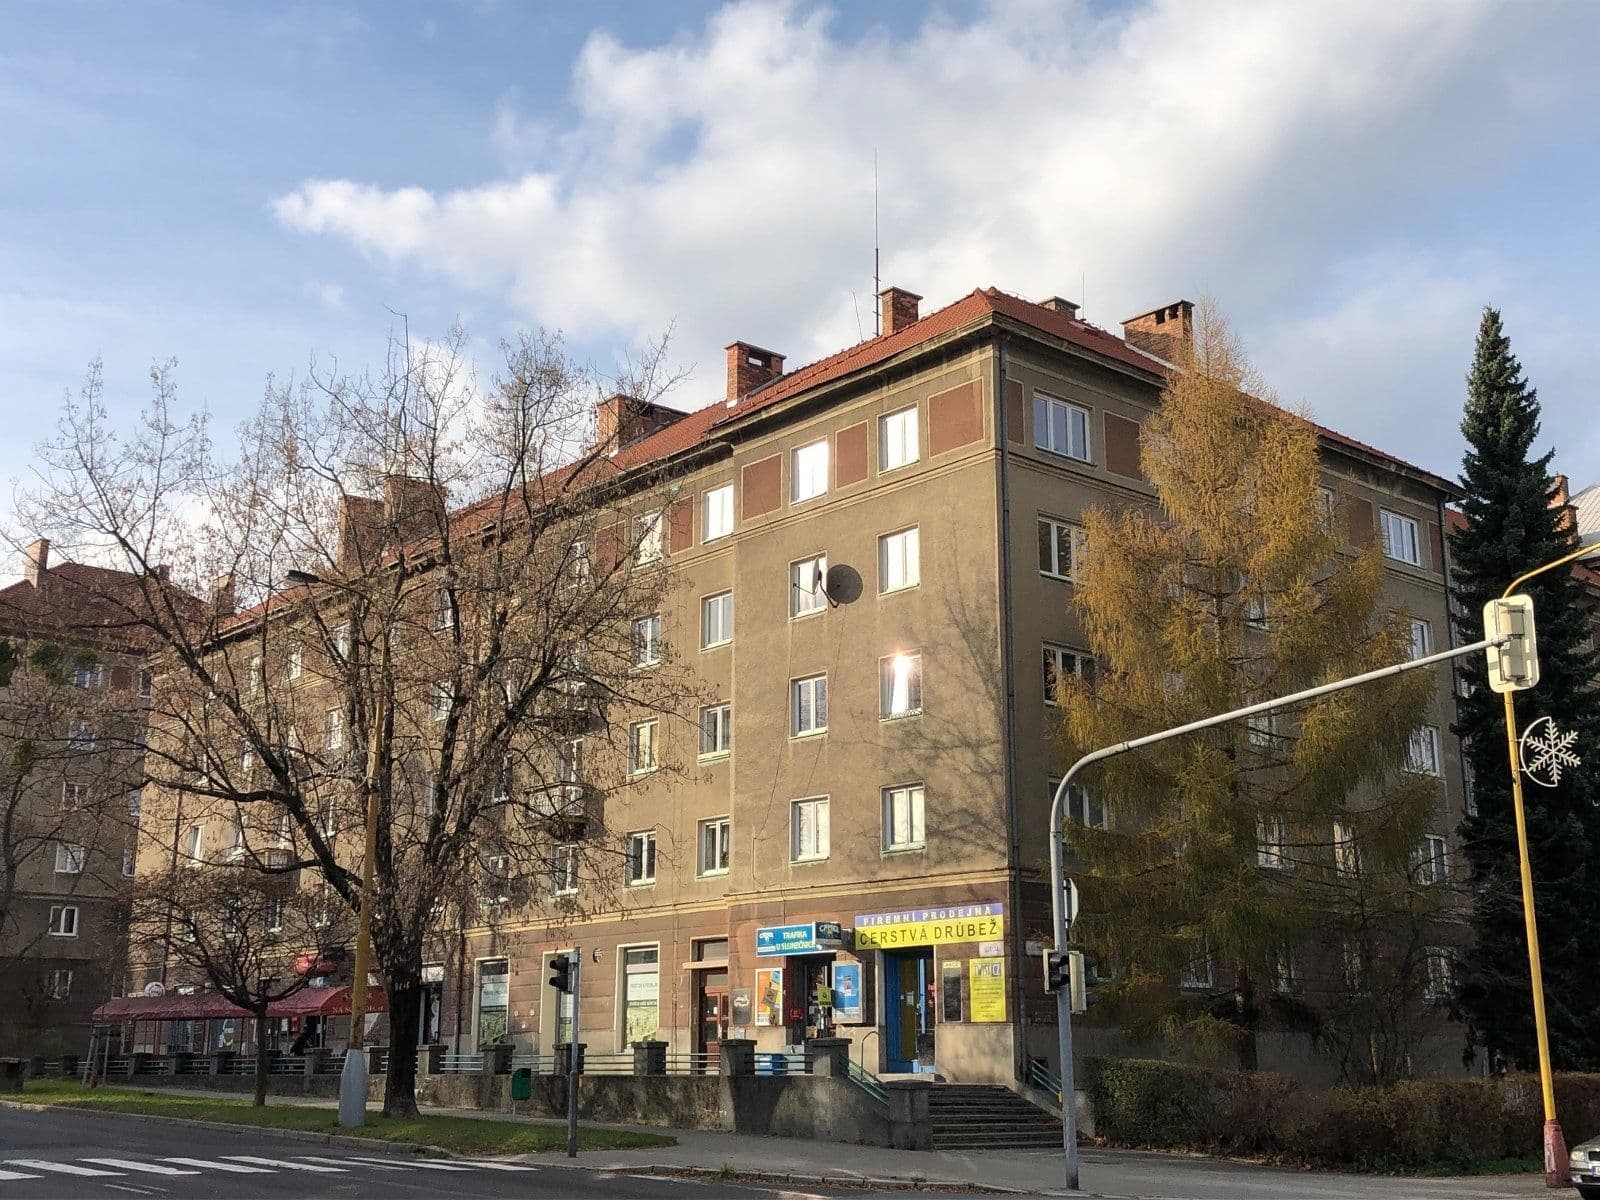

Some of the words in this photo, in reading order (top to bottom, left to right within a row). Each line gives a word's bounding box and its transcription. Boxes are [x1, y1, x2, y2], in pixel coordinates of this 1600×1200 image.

[863, 912, 916, 926] FIREMNÍ
[922, 906, 992, 921] PRODEJNA
[783, 931, 807, 939] TRAFIKA
[860, 924, 928, 945] ČERSTVÁ
